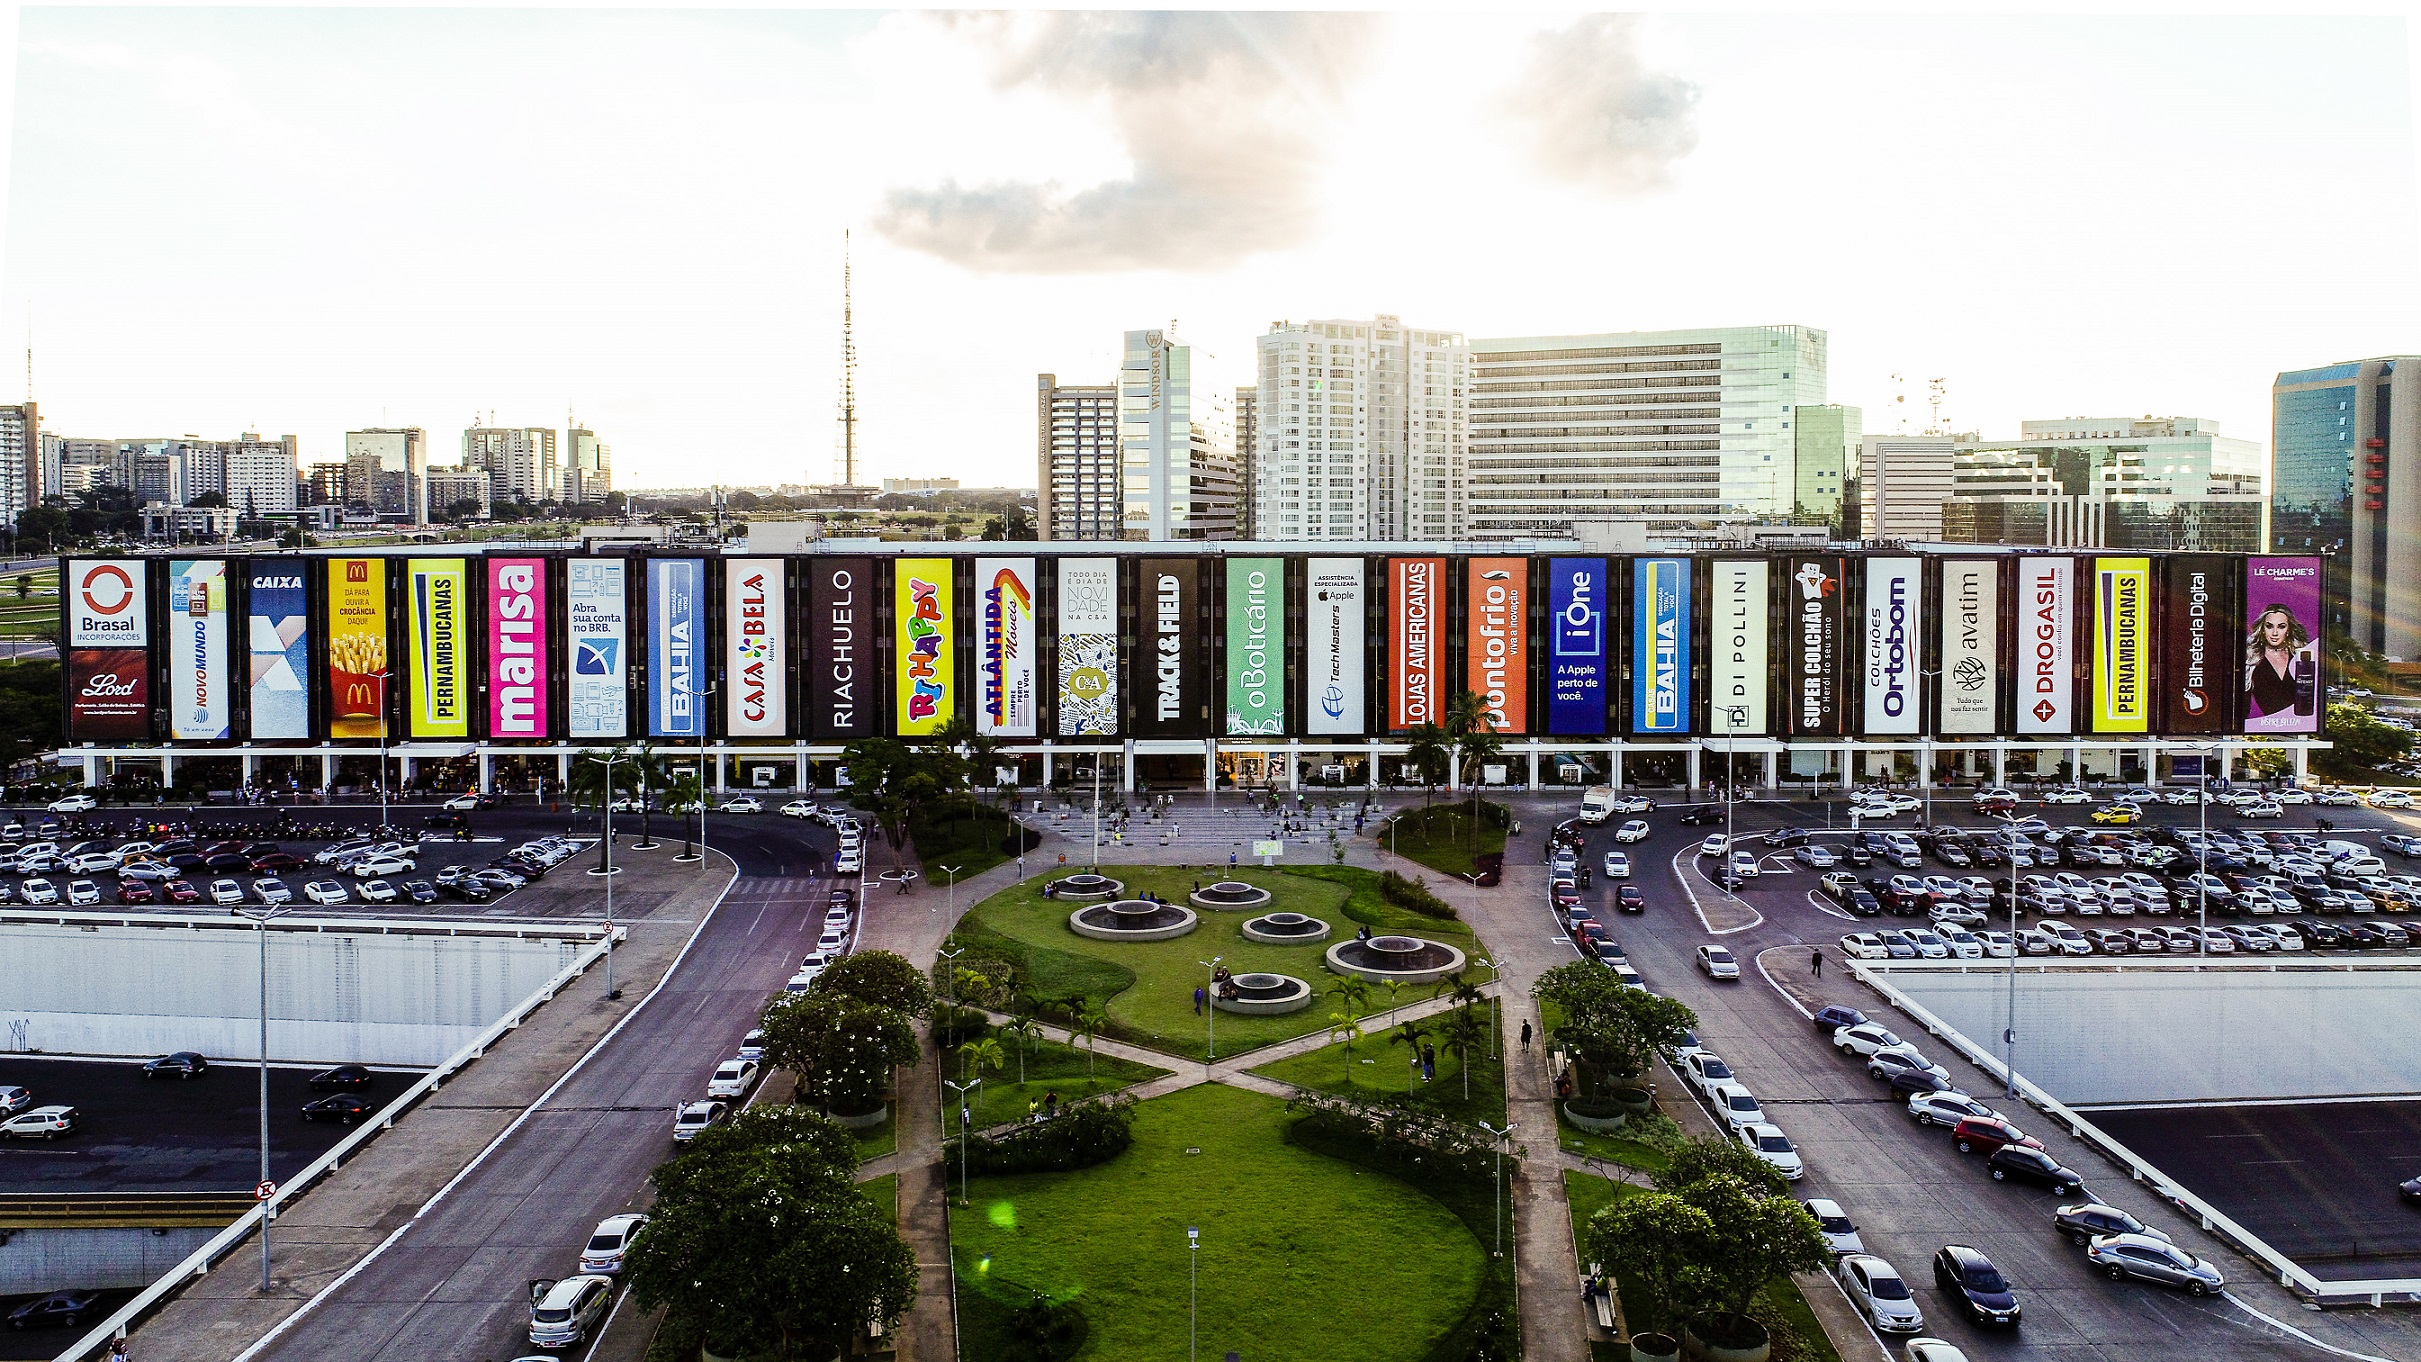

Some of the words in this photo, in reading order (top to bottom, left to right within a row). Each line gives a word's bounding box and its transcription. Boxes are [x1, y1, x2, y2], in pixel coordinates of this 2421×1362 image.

[1152, 350, 1160, 410] WINDSOR
[252, 576, 302, 589] CAIXA
[2254, 566, 2265, 575] LÉ
[340, 607, 376, 615] CROCÂNCIA
[573, 603, 597, 613] Abra
[743, 573, 765, 635] BELA
[1068, 587, 1107, 599] NOVI
[1068, 600, 1107, 612] DADE
[1330, 591, 1354, 601] Apple
[1509, 589, 1518, 629] inovação
[1959, 572, 1979, 650] avatim
[2190, 572, 2207, 614] Digital
[82, 617, 134, 631] Brasal
[573, 615, 590, 623] sua
[593, 614, 621, 623] conta
[573, 625, 586, 633] no
[588, 623, 611, 633] BRB.
[1005, 599, 1017, 659] Móveis
[1408, 562, 1427, 669] AMERICANAS
[1733, 572, 1747, 662] POLLINI
[2035, 568, 2055, 694] DROGASIL
[2059, 614, 2062, 623] em
[77, 633, 140, 641] INCORPORAÇÕES
[434, 578, 452, 718] PERNAMBUCANAS
[499, 565, 534, 732] marisa
[833, 570, 853, 727] RIACHUELO
[981, 586, 1002, 717] ATLÂNTIDA
[1480, 585, 1511, 729] pontofrio
[1509, 639, 1518, 656] viva
[1802, 601, 1822, 674] COLCHÃO
[1870, 607, 1880, 687] COLCHÕES
[1884, 577, 1906, 718] Ortobom
[2118, 577, 2136, 713] PERNAMBUCANAS
[2189, 615, 2204, 688] Bilheteria
[195, 620, 206, 707] NOVOMUNDO
[671, 620, 690, 716] BAHIA
[1075, 675, 1102, 690] C&A
[1558, 666, 1566, 674] A
[1567, 665, 1596, 676] Apple
[1558, 678, 1583, 689] perto
[1585, 678, 1598, 688] de
[1657, 618, 1675, 714] BAHIA
[1823, 662, 1831, 674] do
[82, 674, 137, 697] Lord
[743, 661, 765, 721] CASA
[1024, 689, 1029, 698] DE
[1408, 673, 1427, 725] LOJAS
[1558, 691, 1583, 701] você.
[1648, 688, 1656, 713] CASAS
[1733, 674, 1745, 696] DI
[1804, 677, 1821, 728] SUPER
